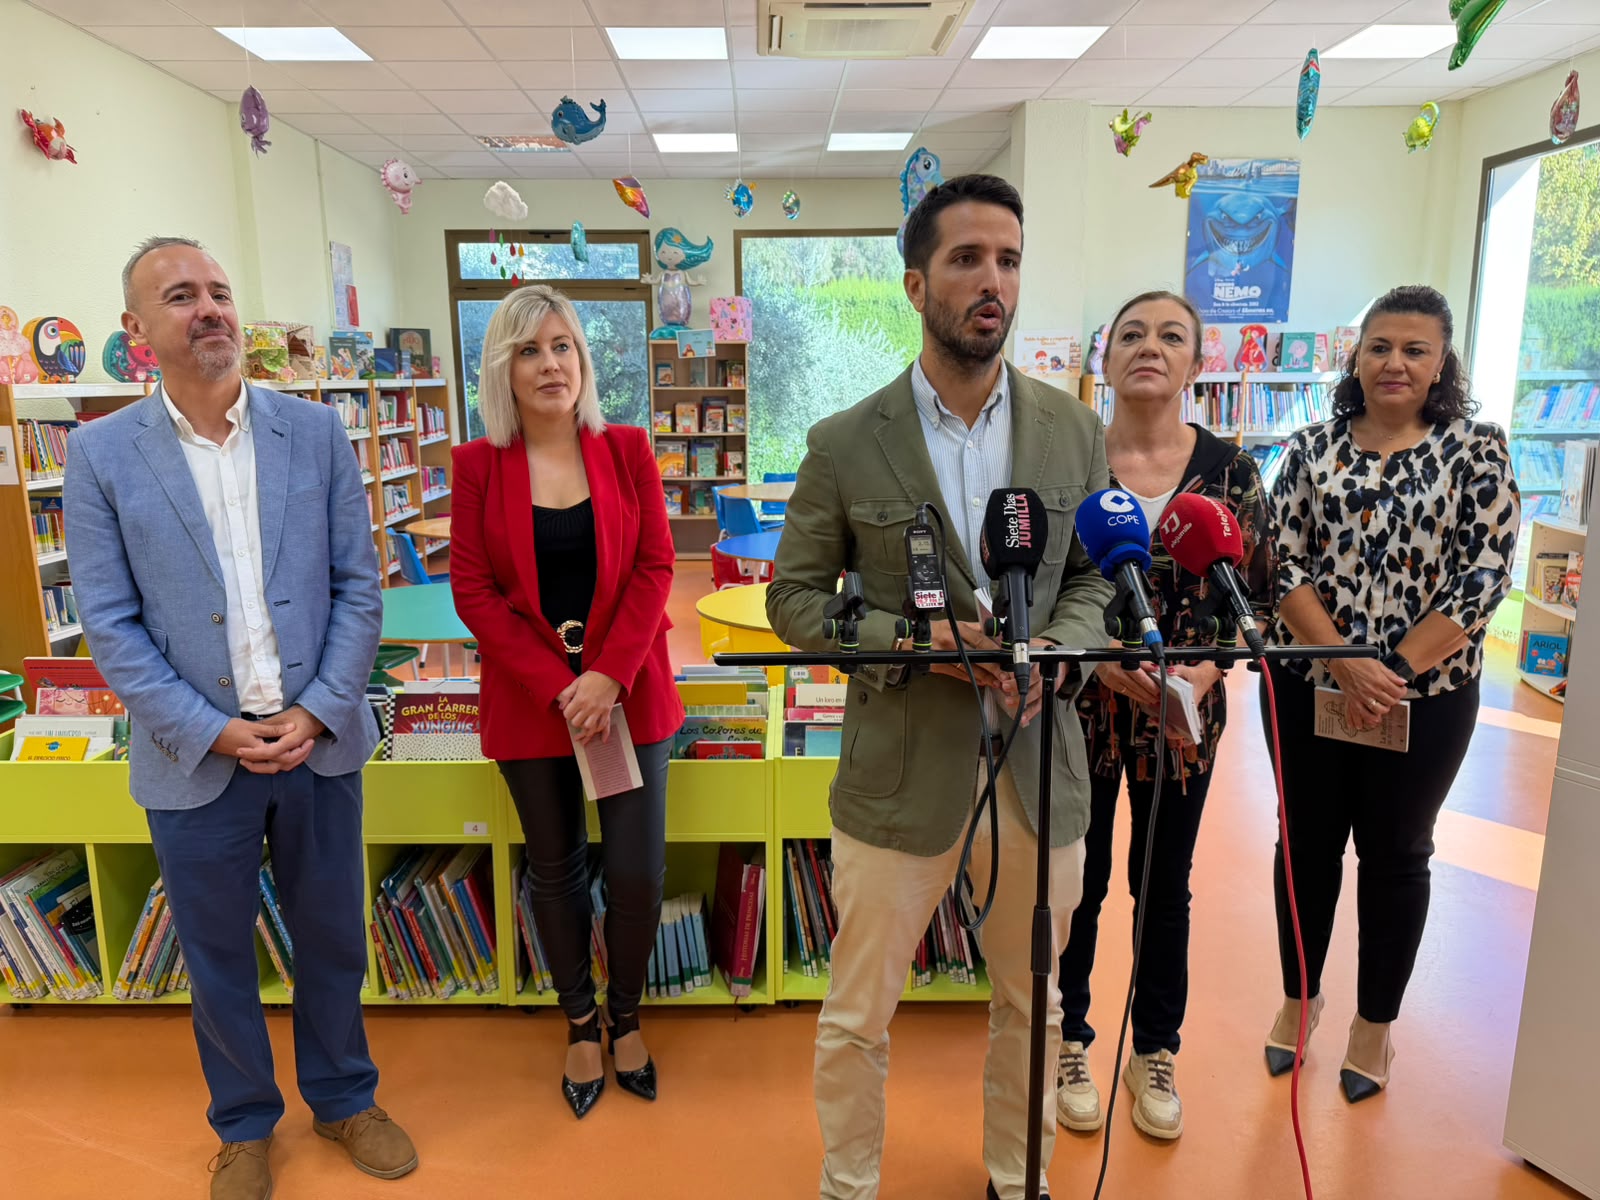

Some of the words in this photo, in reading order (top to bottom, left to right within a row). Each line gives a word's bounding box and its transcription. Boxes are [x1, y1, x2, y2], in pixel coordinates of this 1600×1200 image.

[1212, 285, 1262, 299] NEMO
[1003, 493, 1018, 516] Días
[1015, 493, 1032, 549] JUMILLA
[1107, 514, 1140, 527] COPE
[1005, 516, 1020, 548] Siete
[915, 591, 937, 599] Siete
[1532, 640, 1563, 651] ARIOL
[438, 695, 449, 703] LA
[401, 704, 434, 717] GRAN
[437, 703, 479, 716] CARRER
[441, 712, 457, 720] LOS
[411, 721, 474, 734] XUNGUIS
[680, 725, 699, 735] Los
[702, 725, 746, 735] Colores
[748, 726, 764, 735] de
[472, 824, 478, 832] 4
